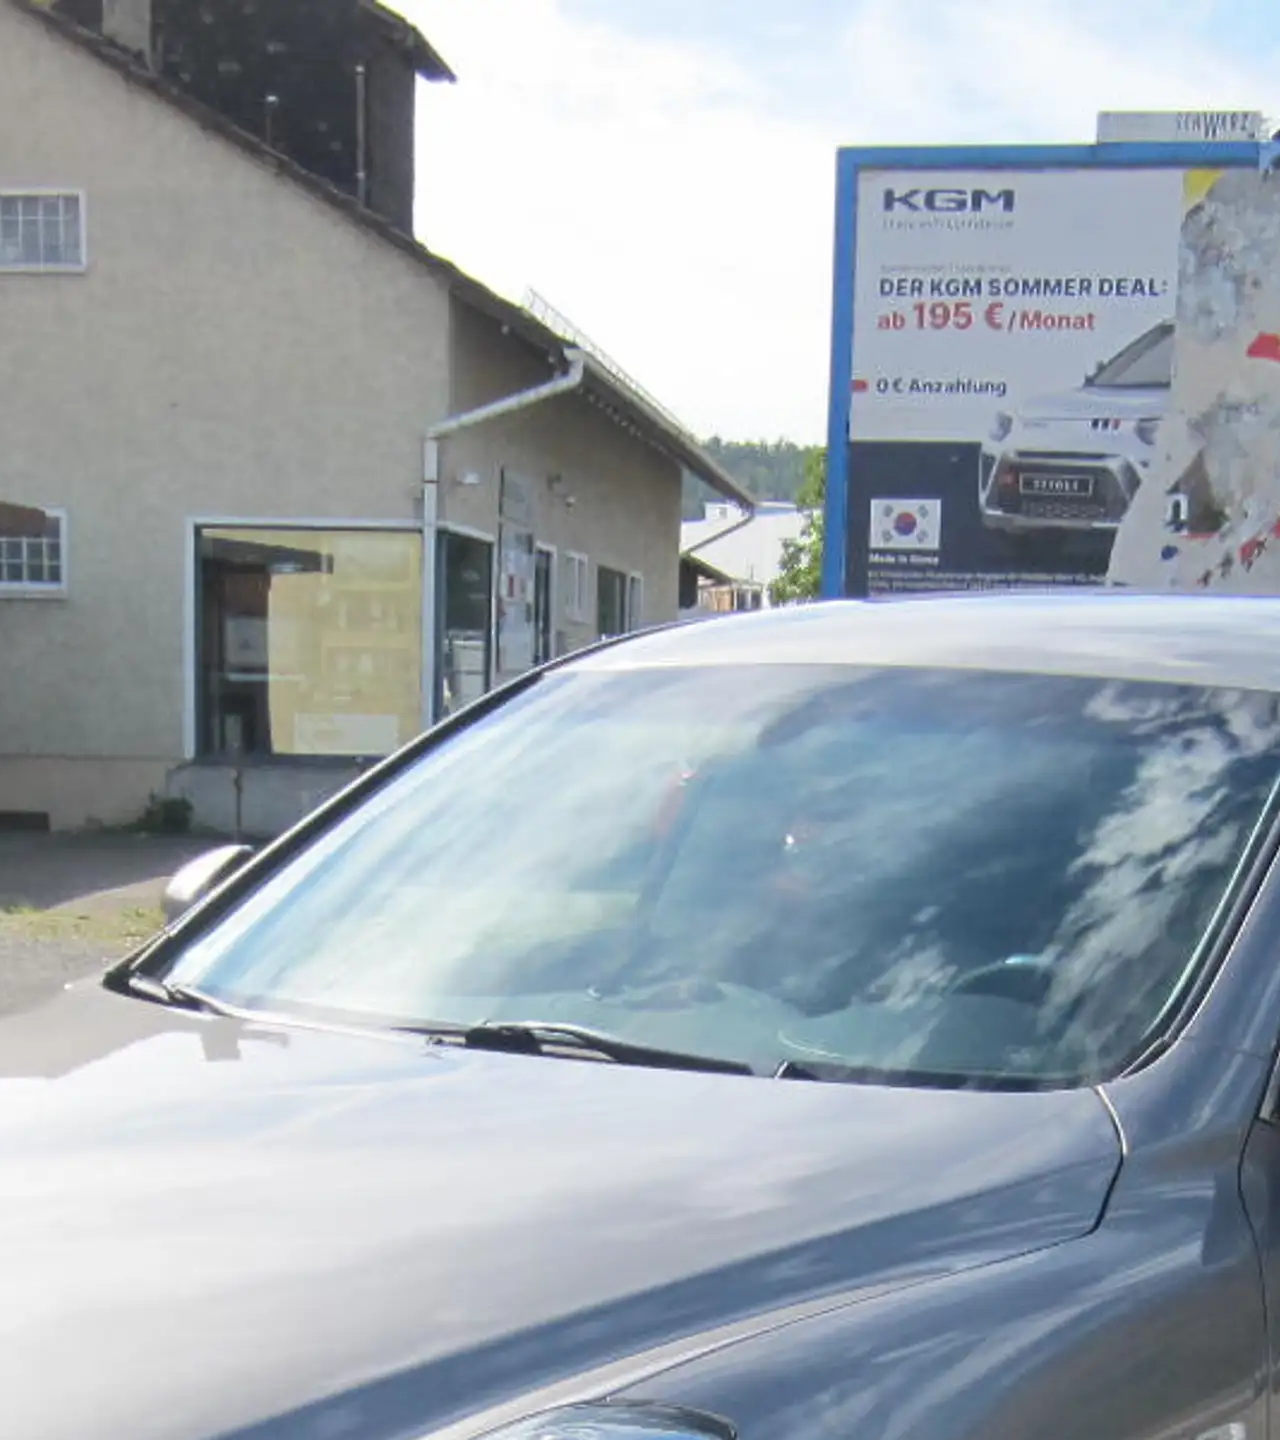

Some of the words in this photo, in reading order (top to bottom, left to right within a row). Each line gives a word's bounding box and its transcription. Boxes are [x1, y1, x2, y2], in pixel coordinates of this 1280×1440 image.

[883, 188, 1016, 212] KGM
[879, 278, 923, 297] DER
[930, 278, 983, 297] KGM
[988, 278, 1092, 297] SOMMER
[1098, 278, 1169, 297] DEAL:
[877, 312, 906, 331] ab
[913, 302, 973, 331] 195
[876, 379, 889, 394] 0
[893, 379, 904, 394] €
[909, 378, 1007, 398] Anzahlung
